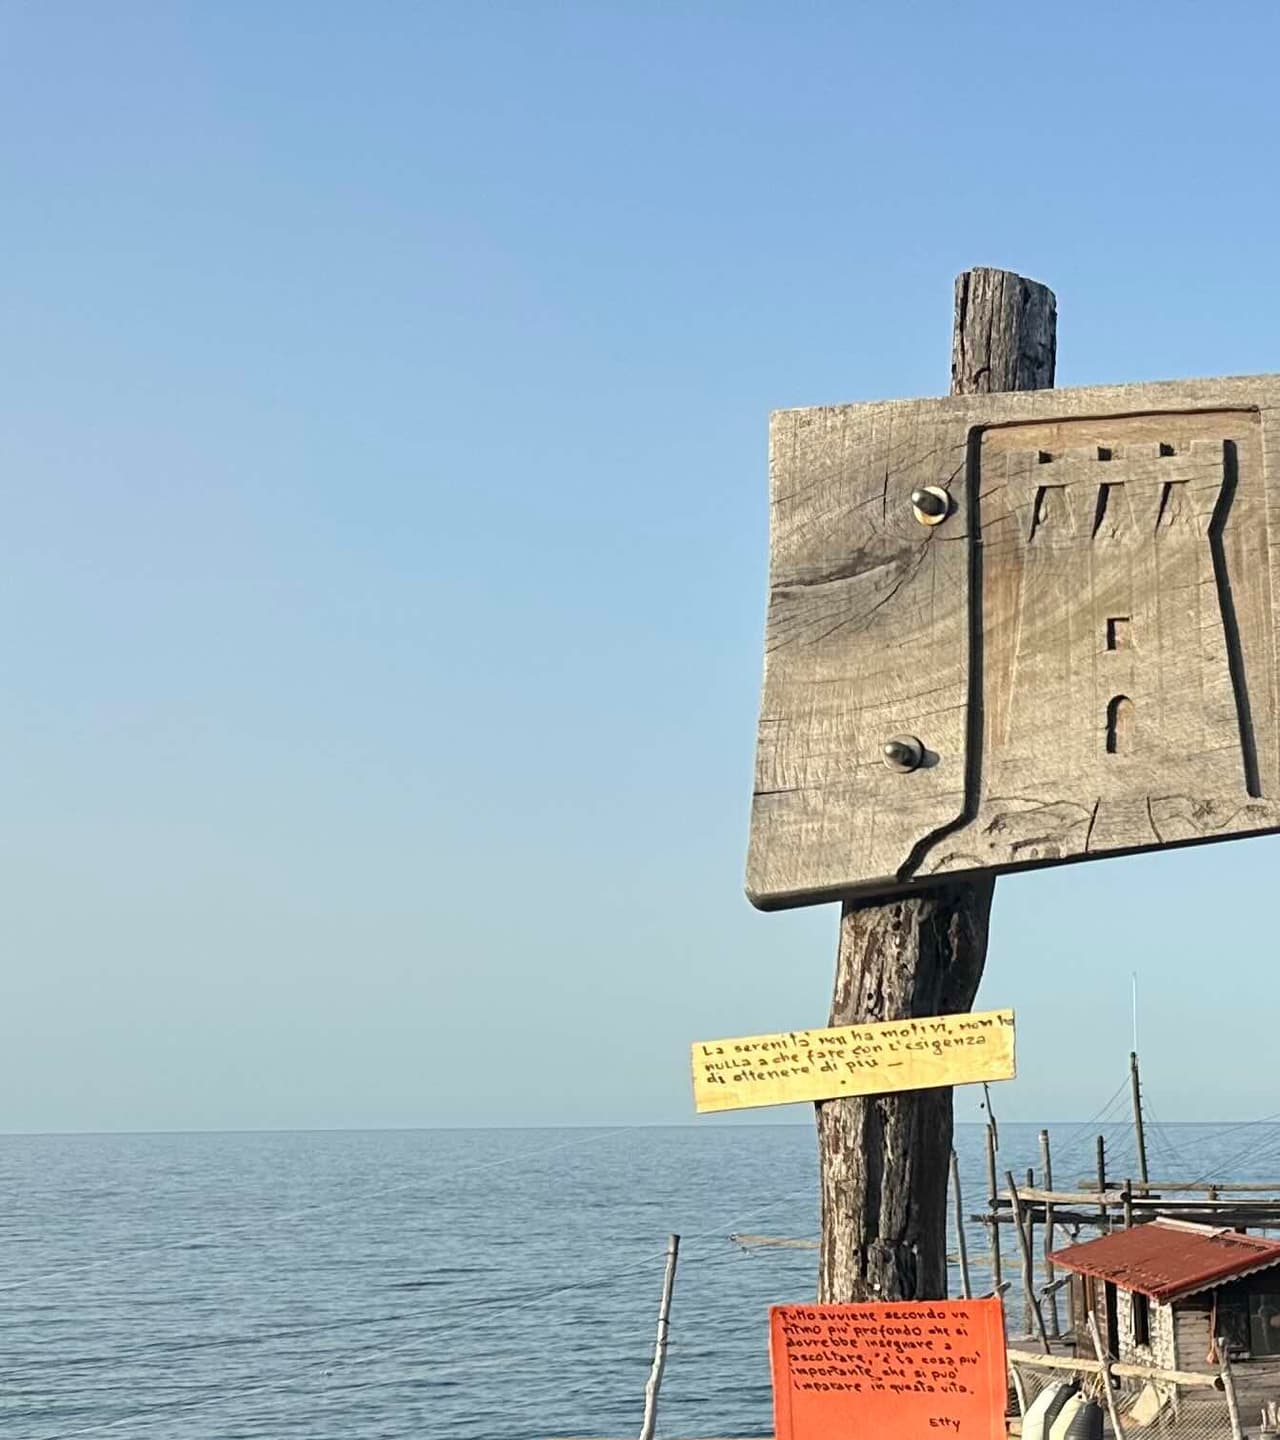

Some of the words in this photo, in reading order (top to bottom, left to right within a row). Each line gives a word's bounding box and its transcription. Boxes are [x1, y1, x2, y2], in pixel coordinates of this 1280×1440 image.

[703, 1046, 724, 1056] La
[851, 1030, 874, 1042] ha
[960, 1018, 993, 1031] non
[759, 1058, 768, 1066] a
[772, 1052, 800, 1064] che
[807, 1049, 845, 1065] fare
[706, 1072, 726, 1084] di
[733, 1066, 810, 1082] ottenere
[820, 1058, 839, 1073] di
[819, 1311, 877, 1322] avviene
[885, 1308, 946, 1320] secondo
[853, 1325, 921, 1338] profondo
[929, 1326, 950, 1336] che
[786, 1337, 858, 1348] dovrebbe
[865, 1339, 933, 1354] insegnare
[922, 1356, 955, 1366] cosa
[882, 1366, 906, 1377] che
[871, 1383, 885, 1391] in
[890, 1380, 935, 1394] questa
